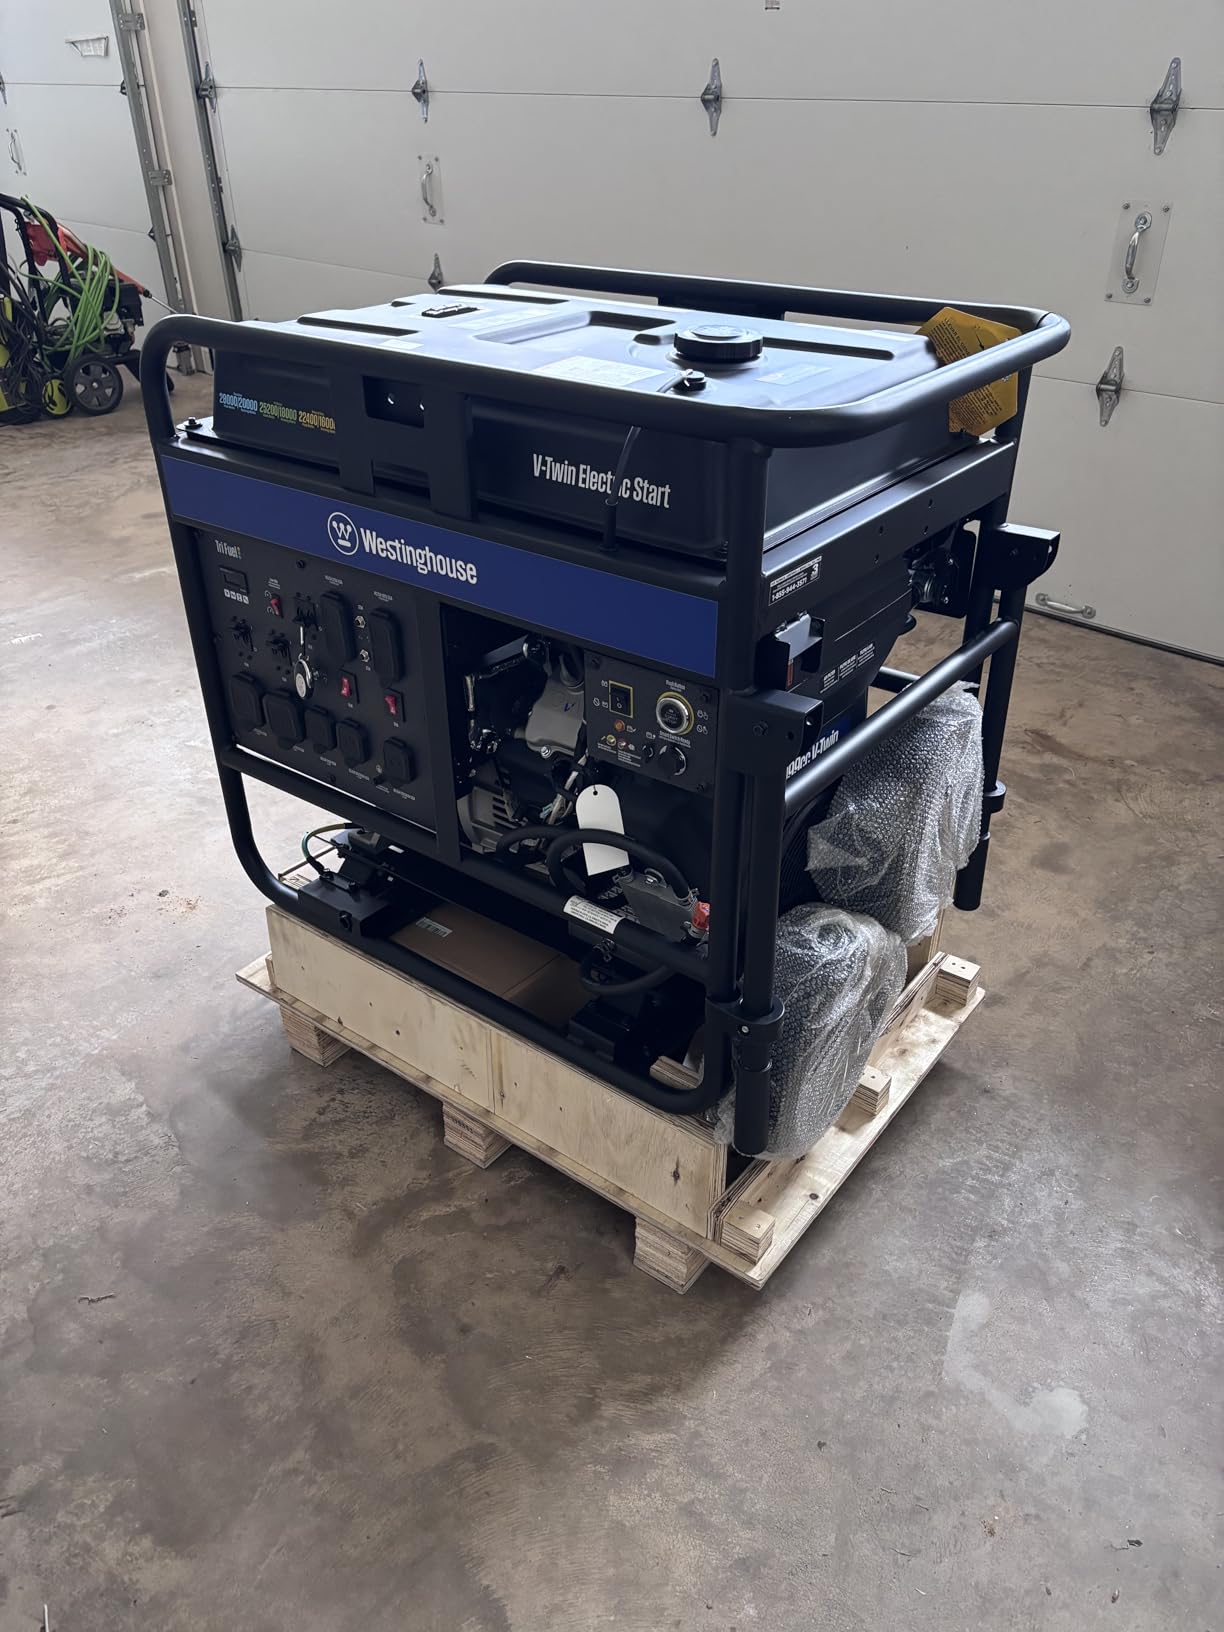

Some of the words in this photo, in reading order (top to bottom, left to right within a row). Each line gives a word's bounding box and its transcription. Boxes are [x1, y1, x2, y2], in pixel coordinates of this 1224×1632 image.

[219, 392, 258, 411] 28000/20000
[259, 402, 297, 420] 25200/18000
[533, 453, 576, 486] V-Twin
[633, 477, 671, 508] Start
[215, 539, 224, 554] Tri
[224, 542, 238, 559] Fuel
[360, 528, 478, 585] Westinghouse
[812, 730, 840, 760] V-Twin
